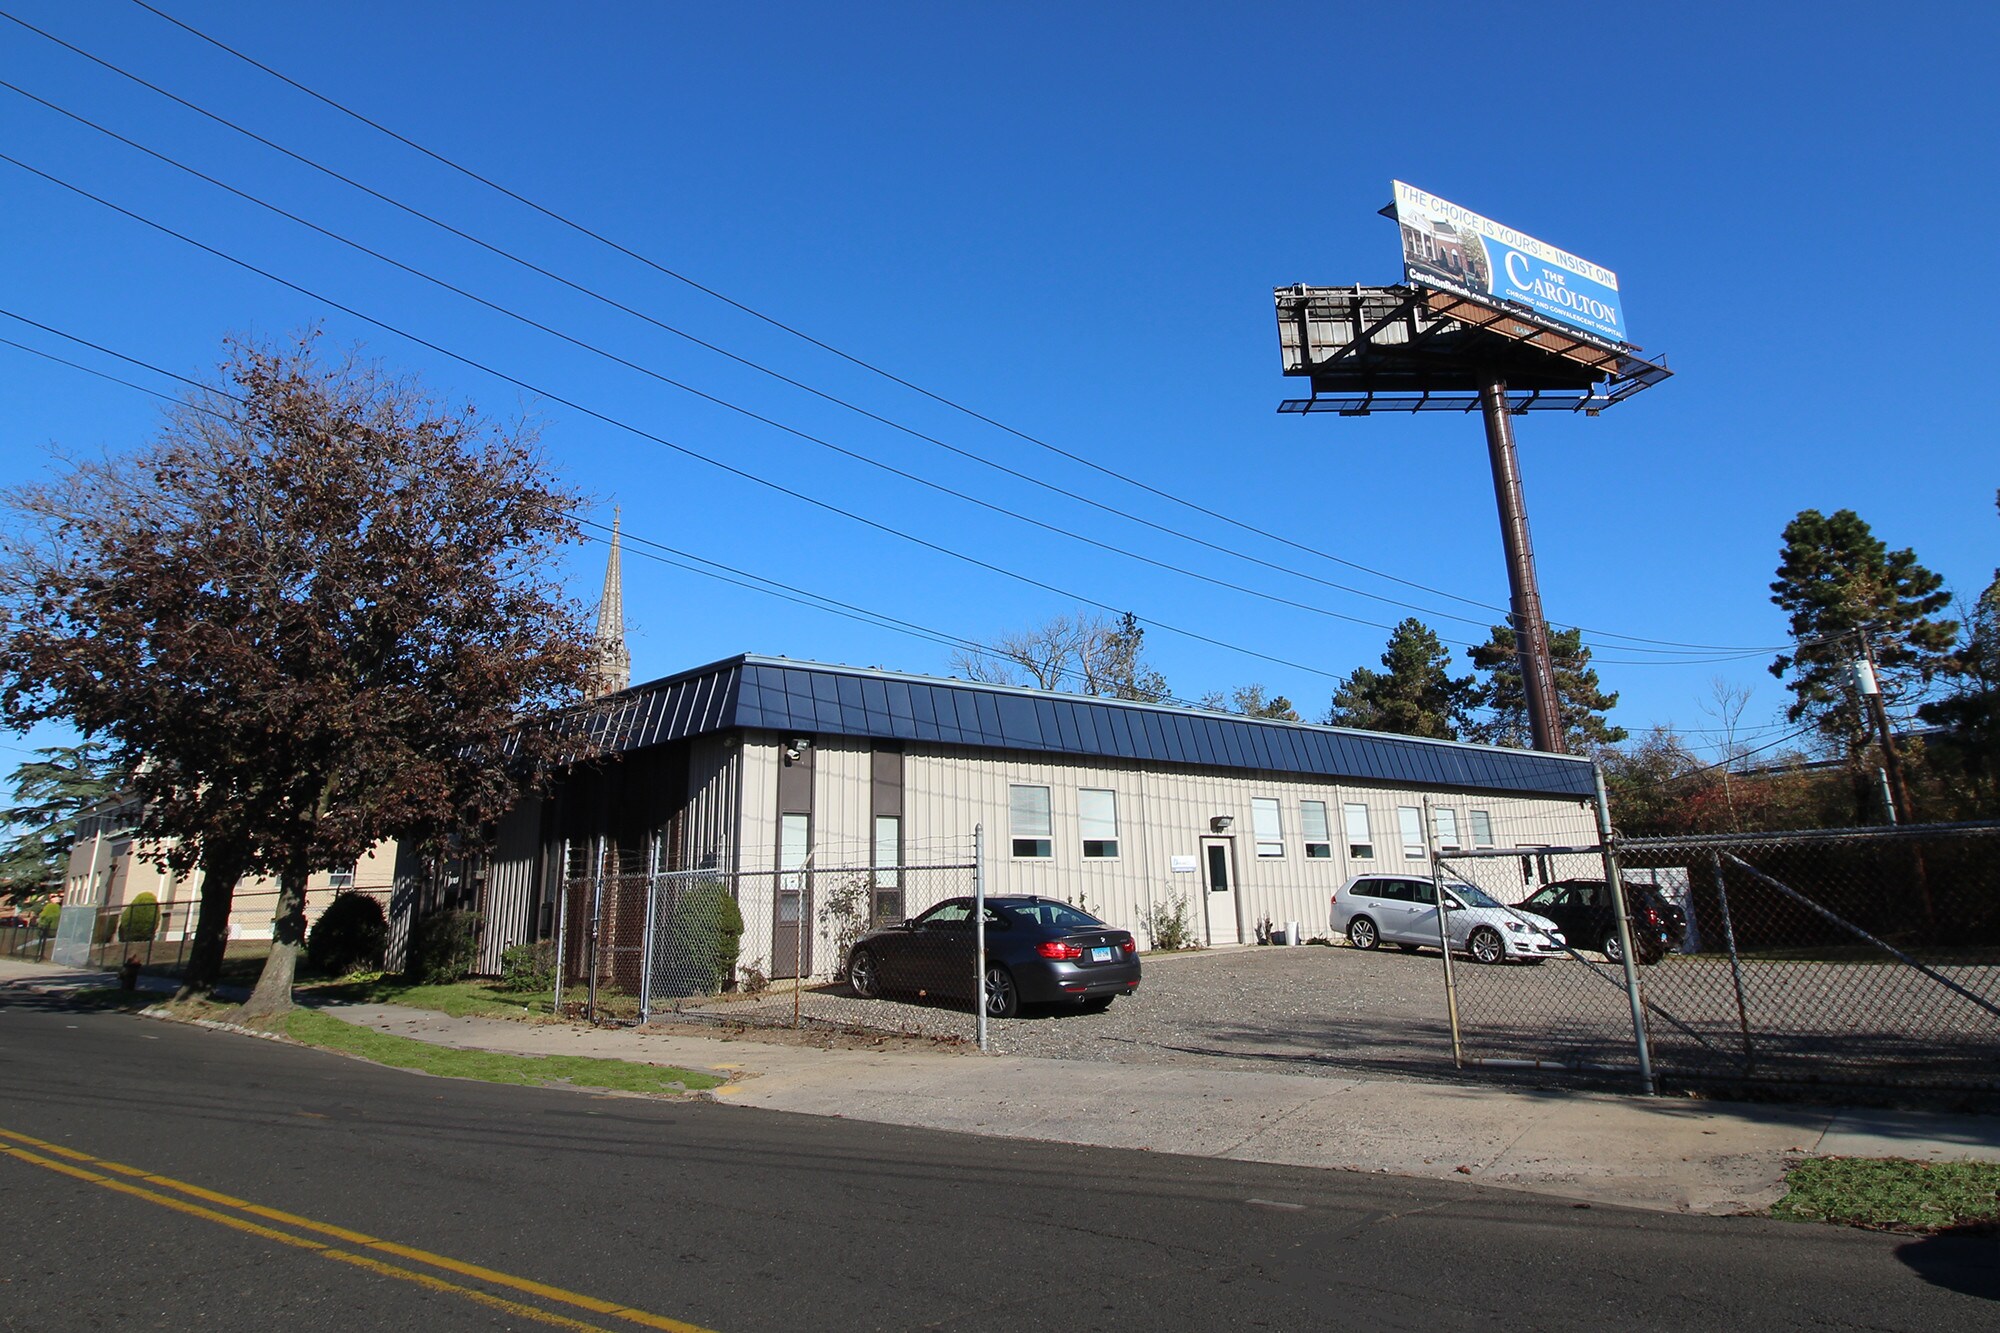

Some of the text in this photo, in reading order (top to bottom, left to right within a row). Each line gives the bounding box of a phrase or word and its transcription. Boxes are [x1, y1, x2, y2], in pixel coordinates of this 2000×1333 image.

[1401, 185, 1427, 206] THE
[1431, 198, 1479, 229] CHOICE
[1482, 220, 1494, 235] IS
[1497, 228, 1542, 255] YOURS!
[1555, 250, 1593, 276] INSIST
[1596, 271, 1615, 285] ON:
[1409, 268, 1489, 303] CaroltonRehabcom
[1542, 269, 1565, 285] THE
[1505, 289, 1624, 338] CHRONIC AND CONVALESCENT HOSPITAL
